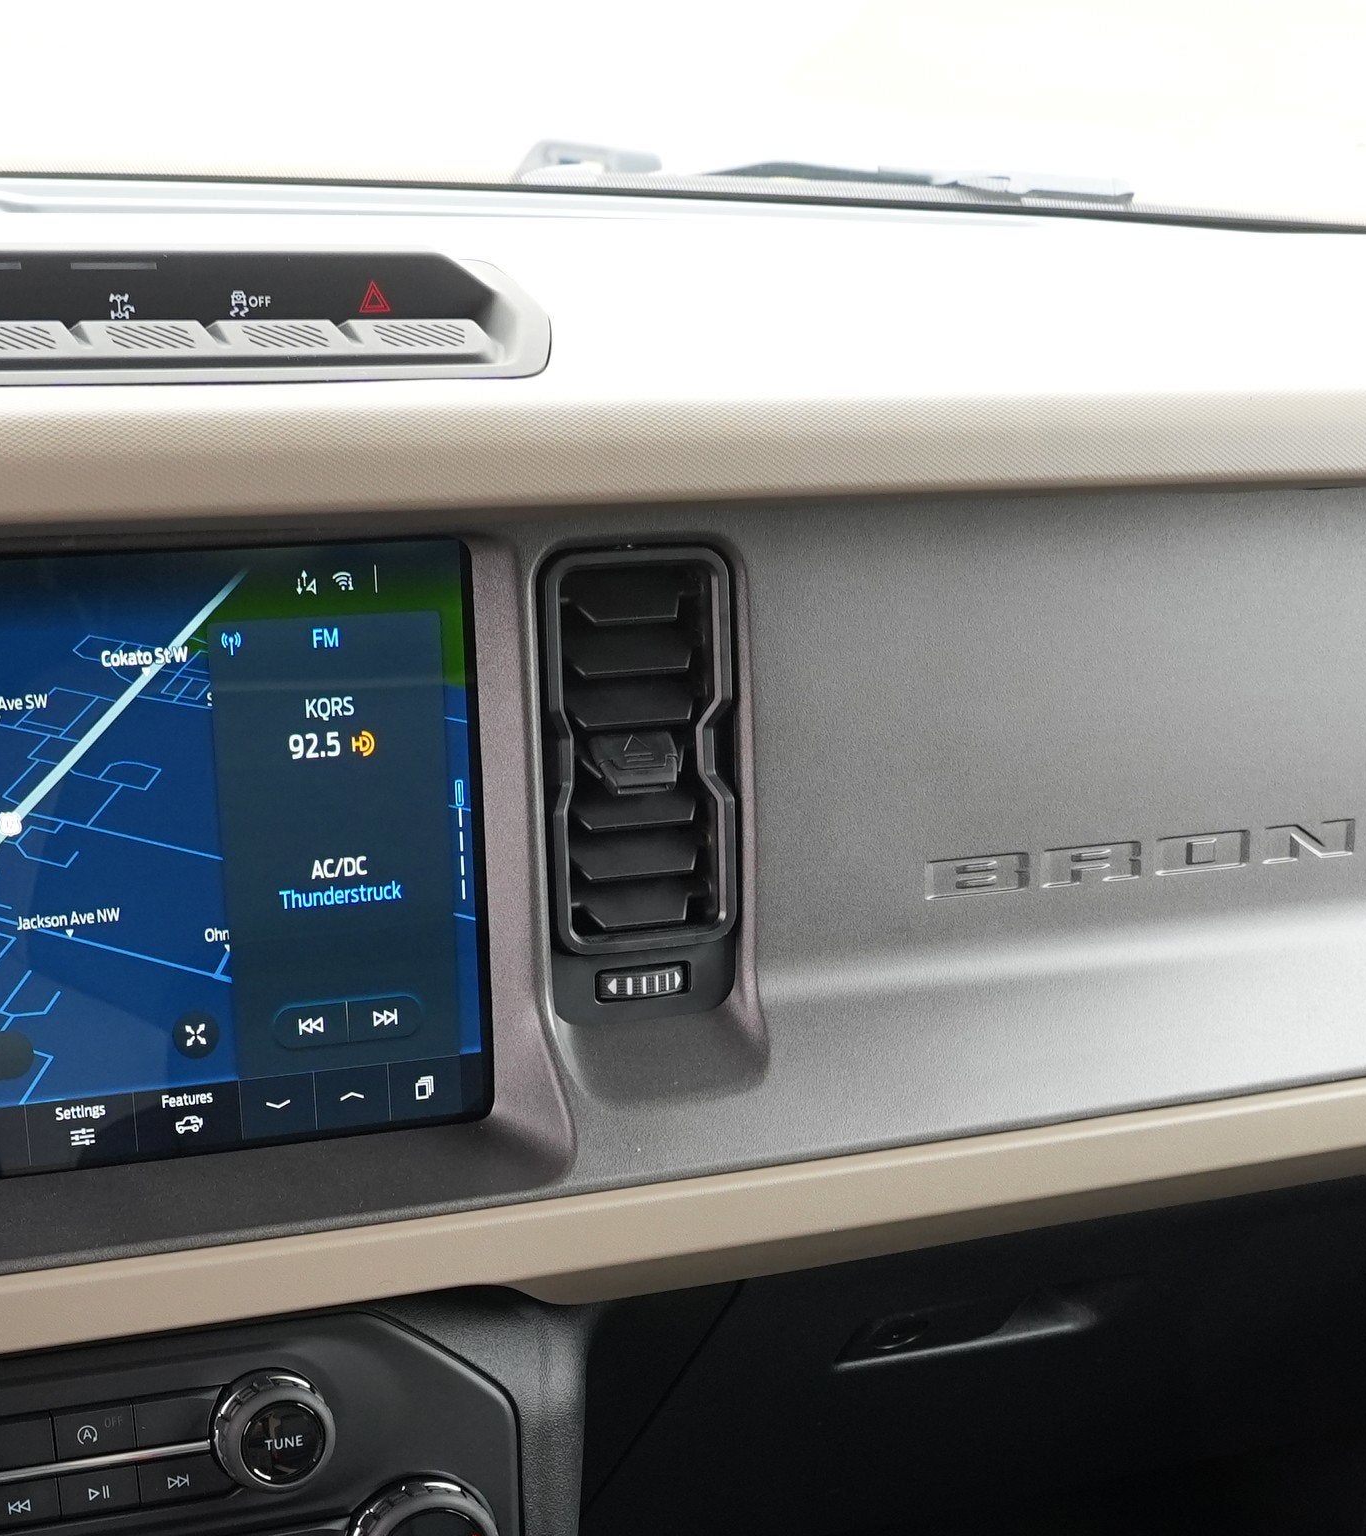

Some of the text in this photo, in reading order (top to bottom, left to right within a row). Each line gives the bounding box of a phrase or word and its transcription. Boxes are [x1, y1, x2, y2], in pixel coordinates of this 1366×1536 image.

[248, 295, 272, 308] OFF
[312, 628, 340, 649] FM
[101, 645, 189, 668] Cokato St W
[24, 694, 49, 711] SW
[305, 696, 355, 721] KQRS
[288, 731, 341, 760] 92.5
[311, 856, 368, 880] AC/DC
[279, 881, 403, 911] Thunderstruck
[17, 907, 121, 932] Jackson Ave NW
[161, 1090, 214, 1109] Features
[54, 1103, 106, 1121] Settings
[103, 1415, 125, 1429] OFF
[264, 1434, 304, 1452] TUNE
